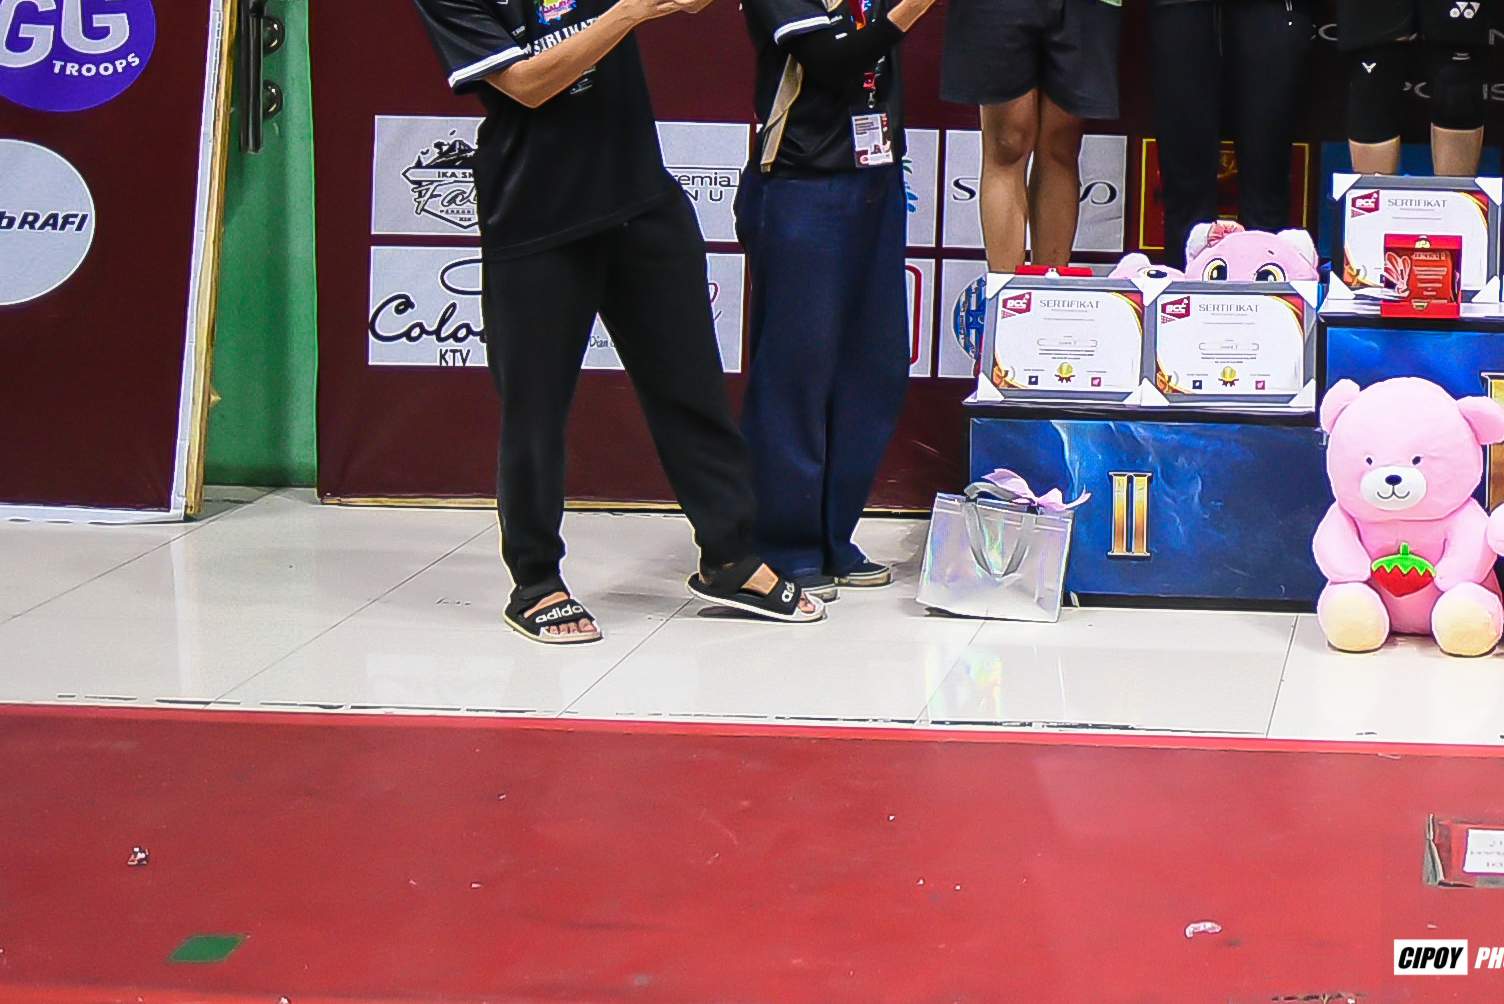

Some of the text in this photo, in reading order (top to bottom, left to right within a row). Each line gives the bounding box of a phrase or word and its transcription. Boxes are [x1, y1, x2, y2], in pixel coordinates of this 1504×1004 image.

[52, 53, 140, 78] TROOPS
[0, 210, 89, 232] bRAFI
[370, 293, 487, 344] Colo
[439, 348, 471, 367] KTV
[535, 604, 583, 624] adida
